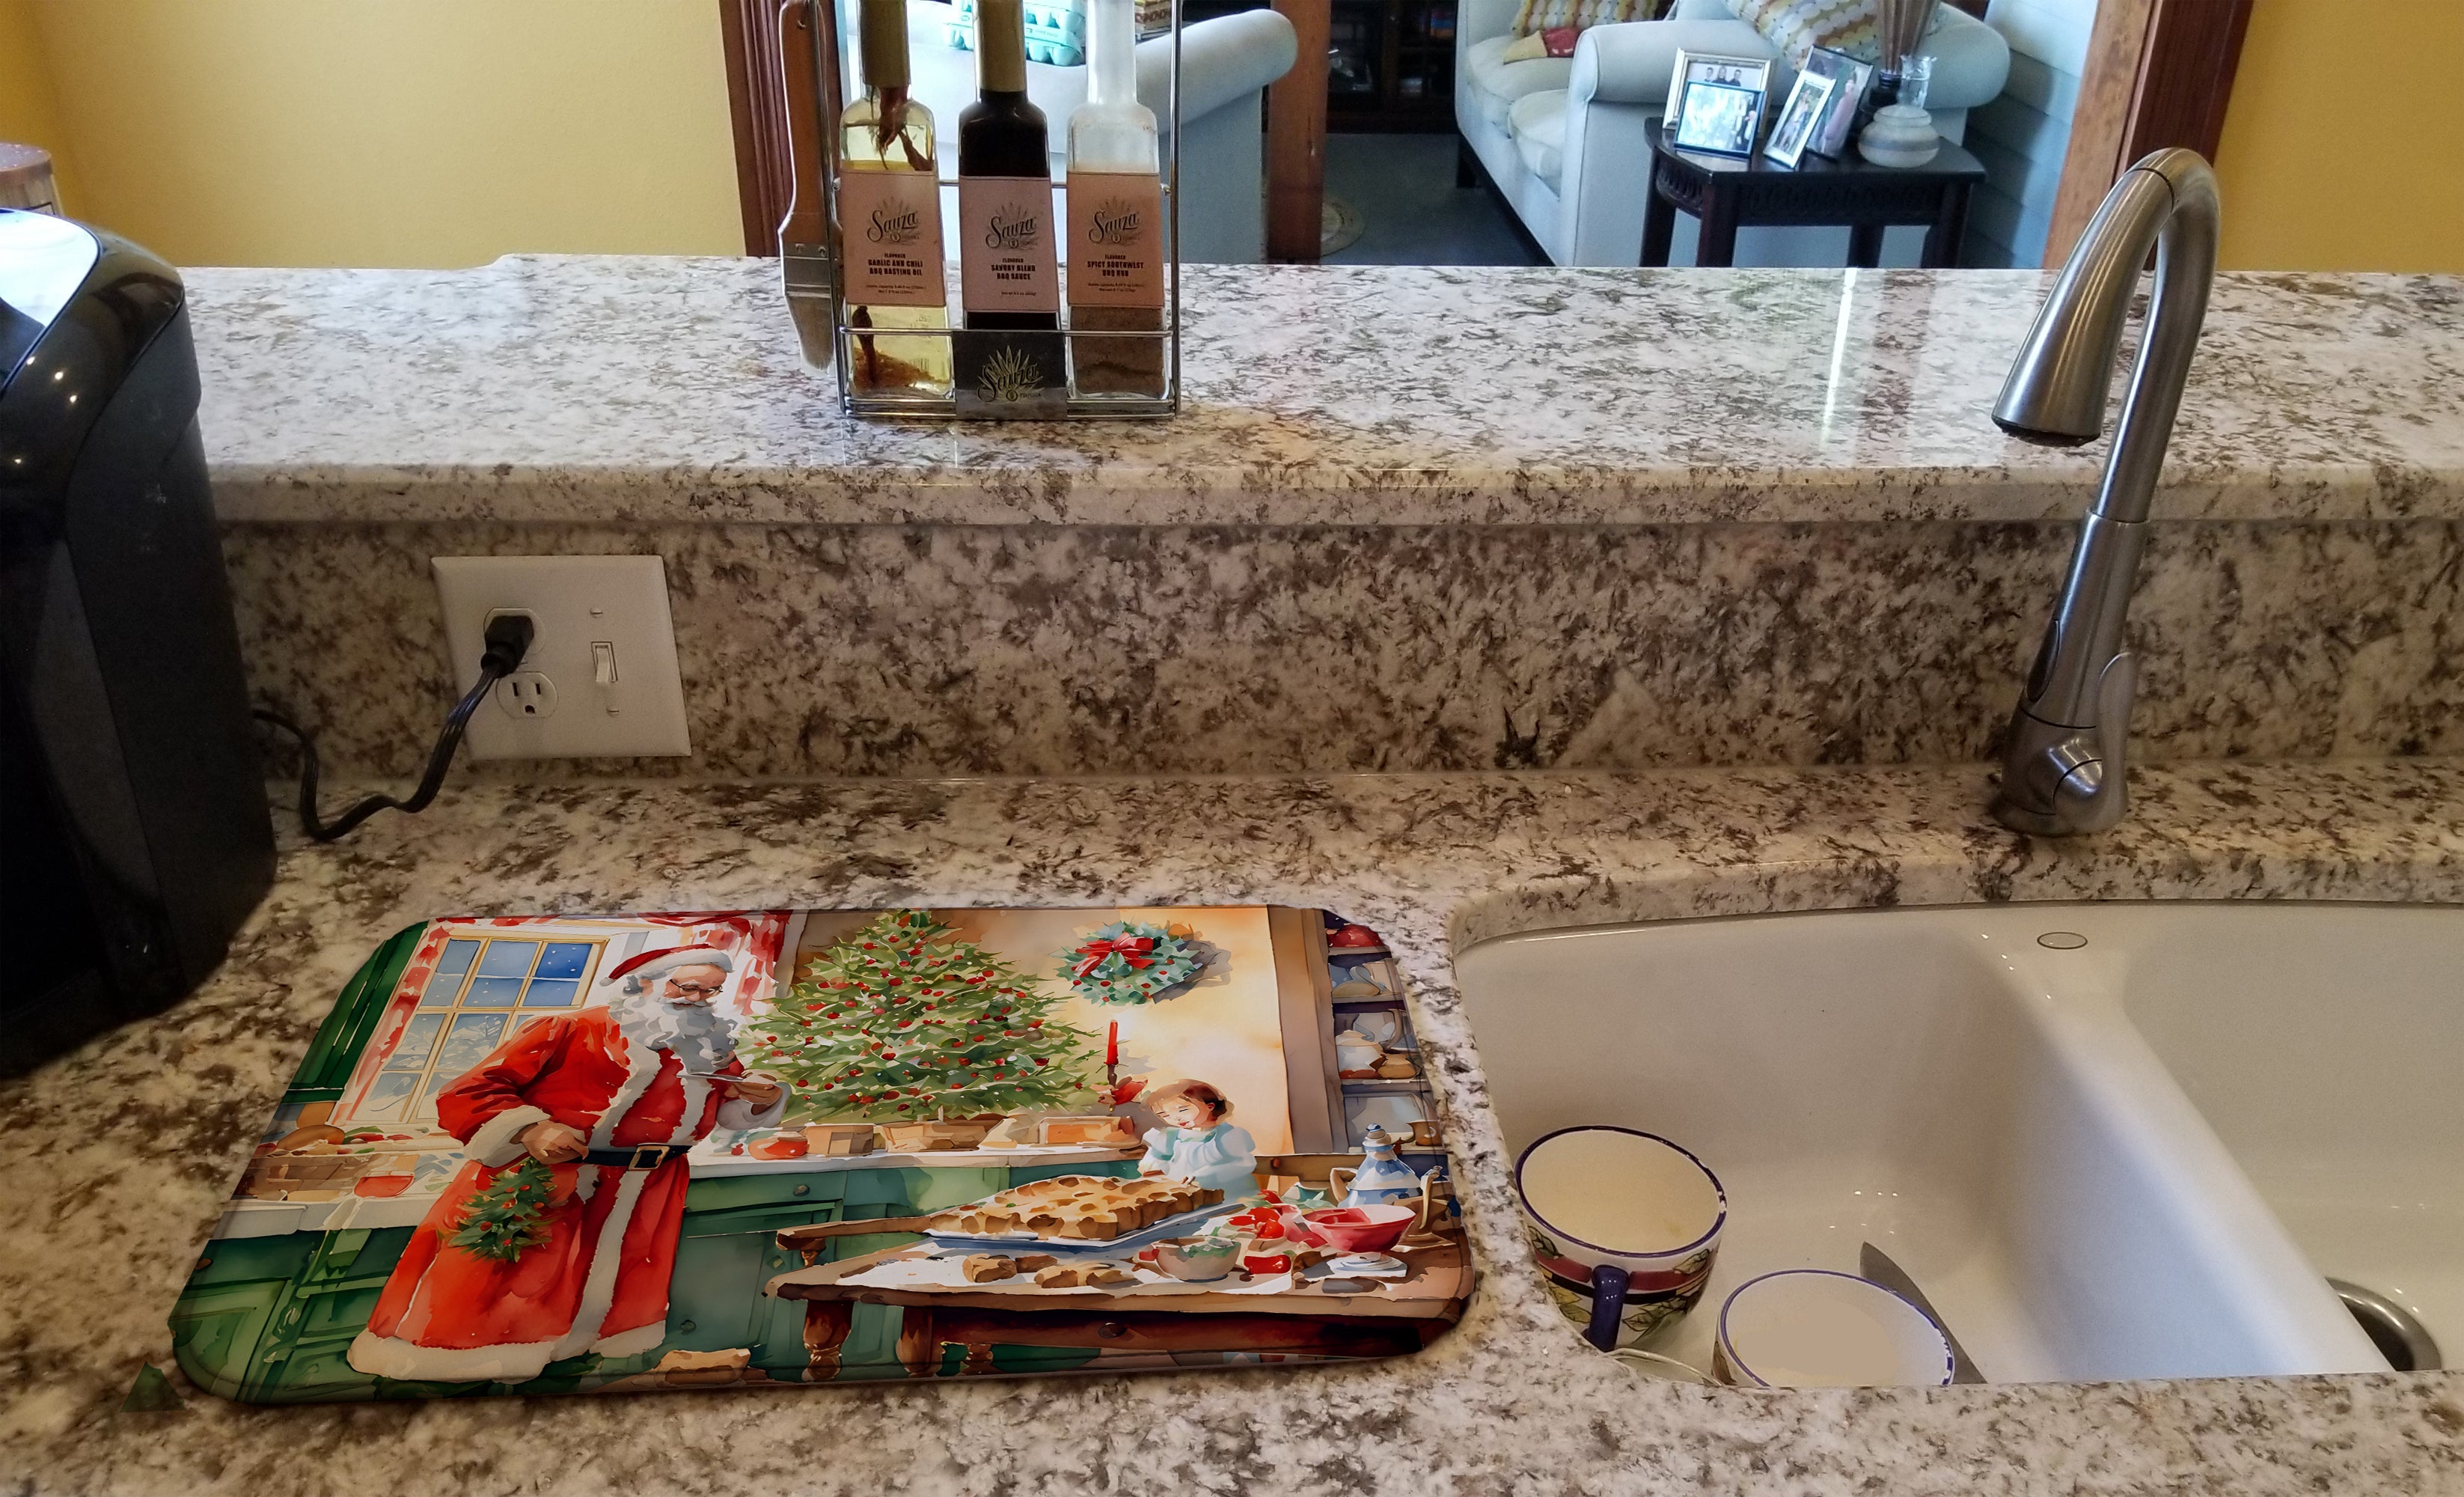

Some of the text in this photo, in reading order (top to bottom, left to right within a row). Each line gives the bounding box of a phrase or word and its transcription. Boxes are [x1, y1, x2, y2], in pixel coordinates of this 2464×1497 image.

[867, 210, 918, 243] Sauza
[985, 216, 1037, 249] Sauza
[1089, 211, 1138, 244] Sauza
[977, 363, 1040, 402] Sauza
